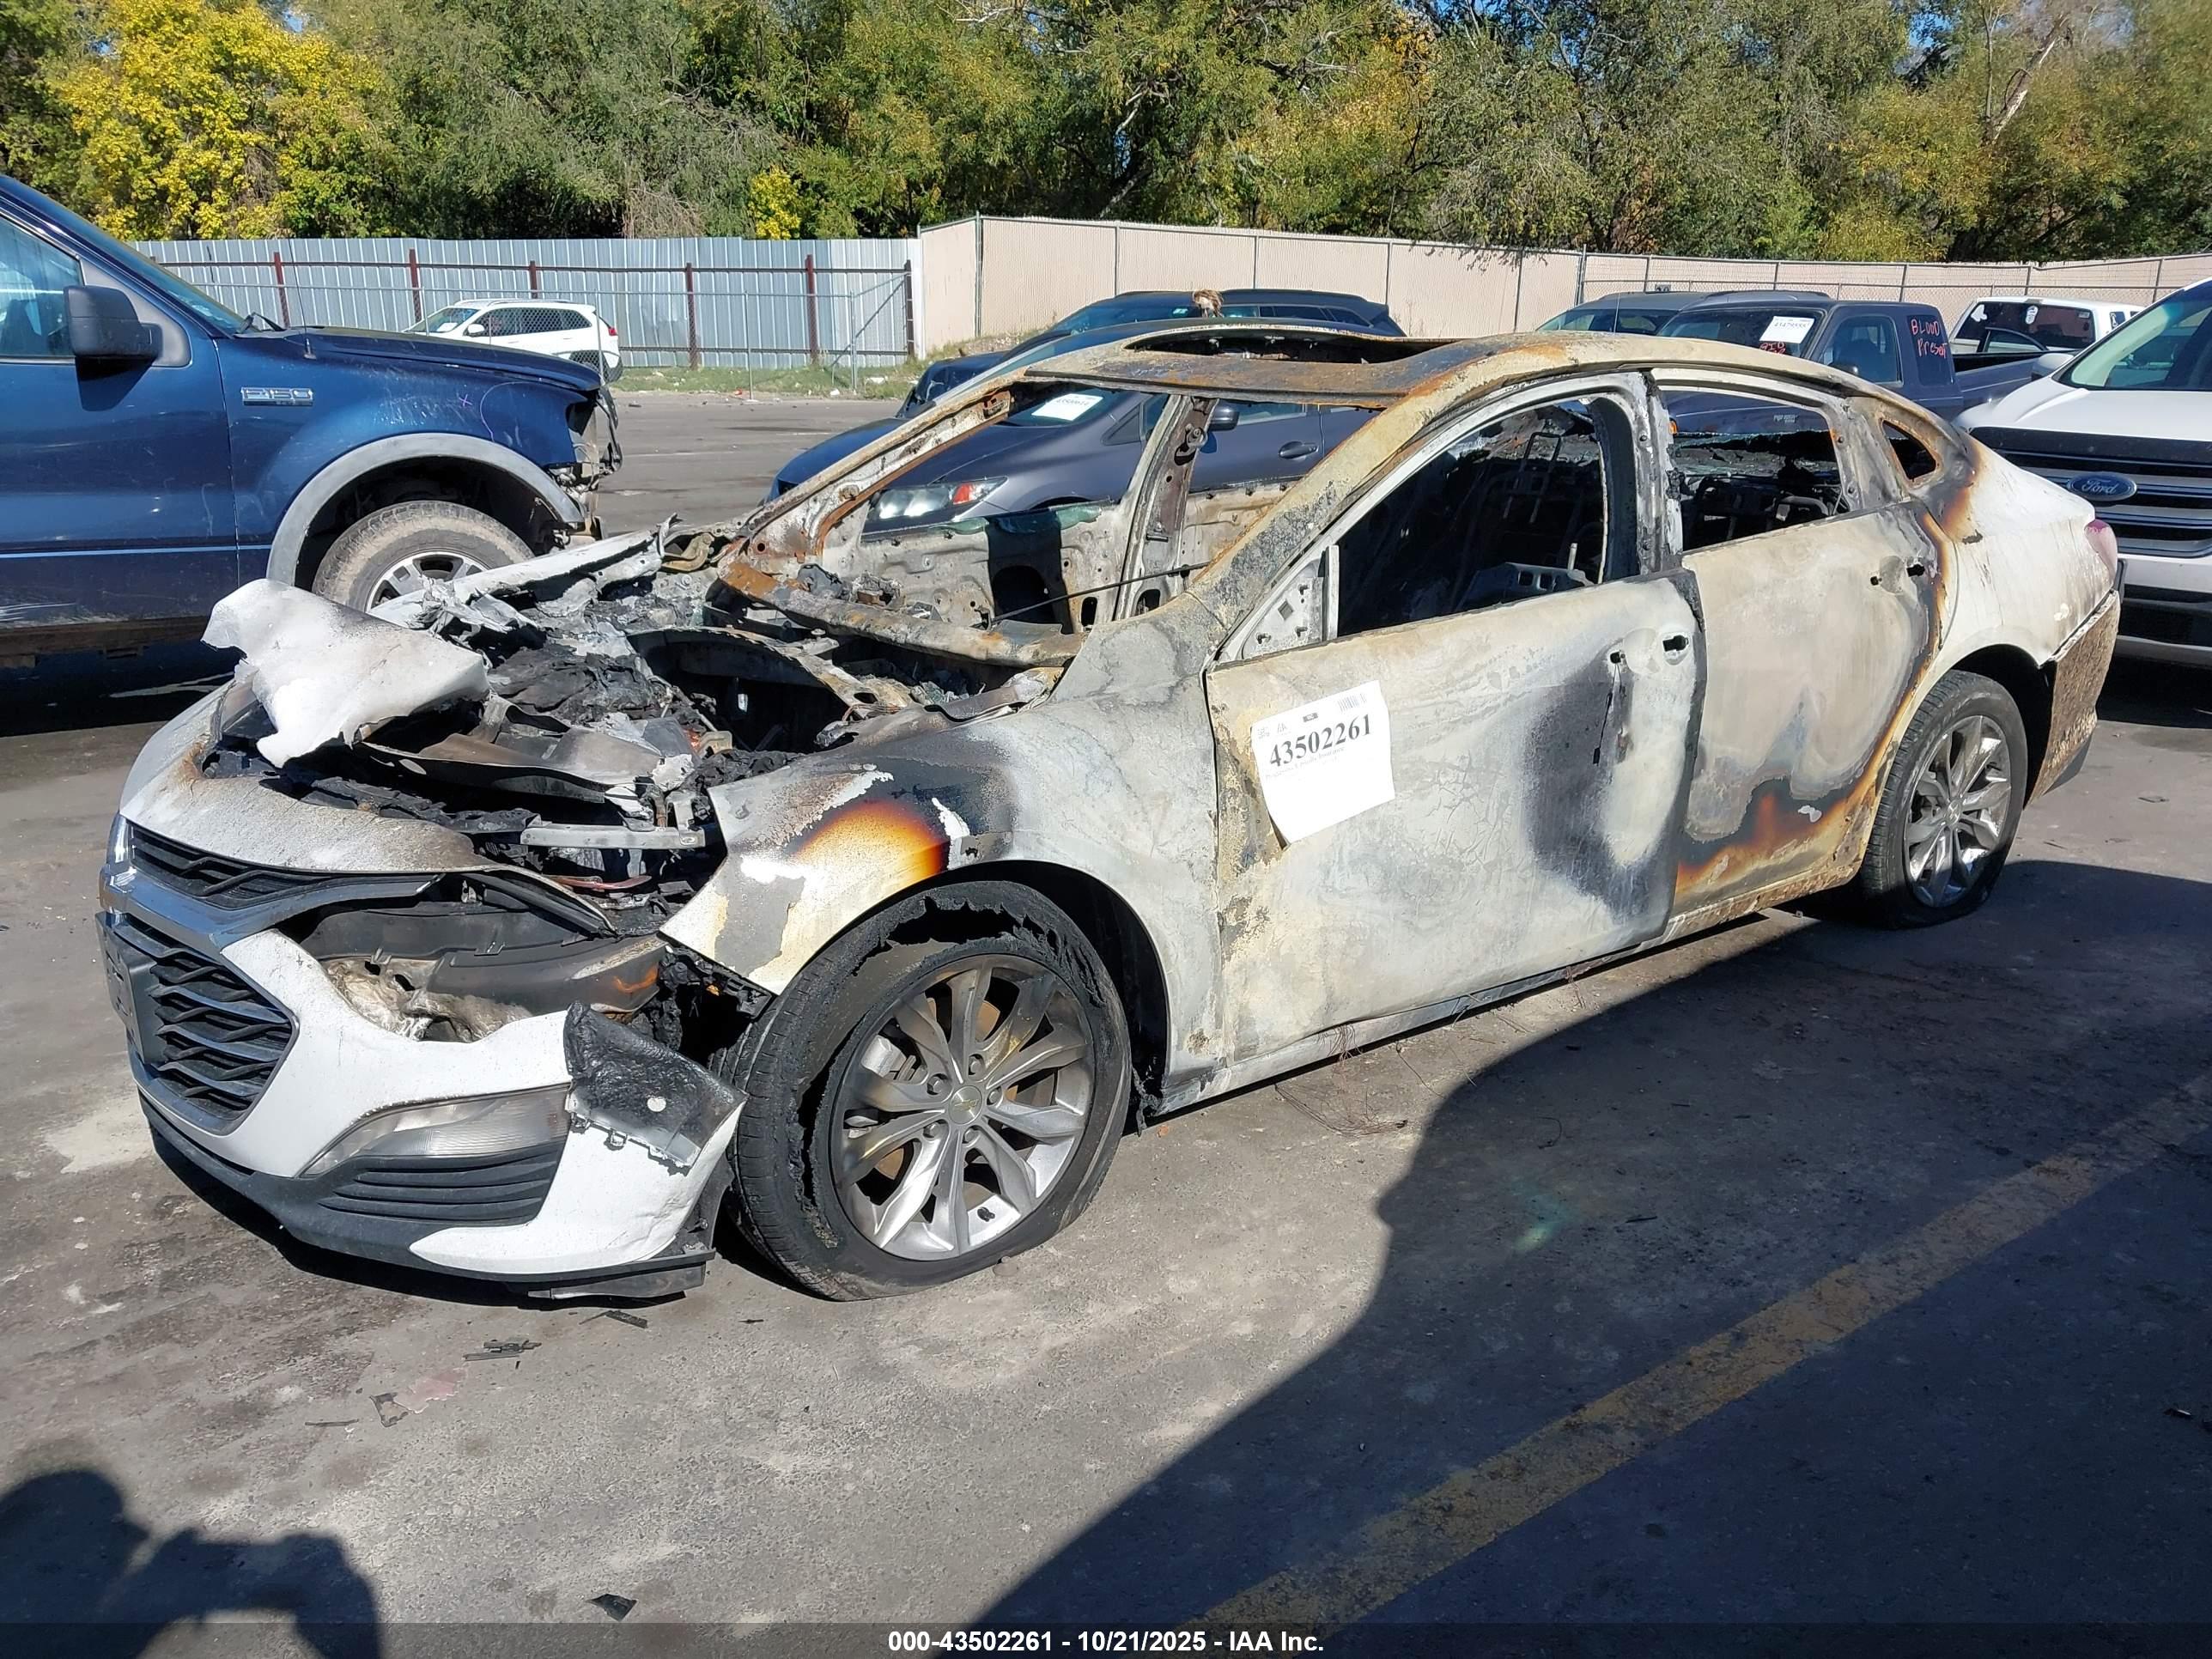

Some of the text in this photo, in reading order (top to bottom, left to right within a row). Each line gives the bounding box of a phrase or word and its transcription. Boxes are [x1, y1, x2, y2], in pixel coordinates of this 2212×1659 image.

[1911, 319, 1940, 336] BLOOD
[2081, 478, 2118, 494] Ford
[1269, 714, 1370, 767] 43502261
